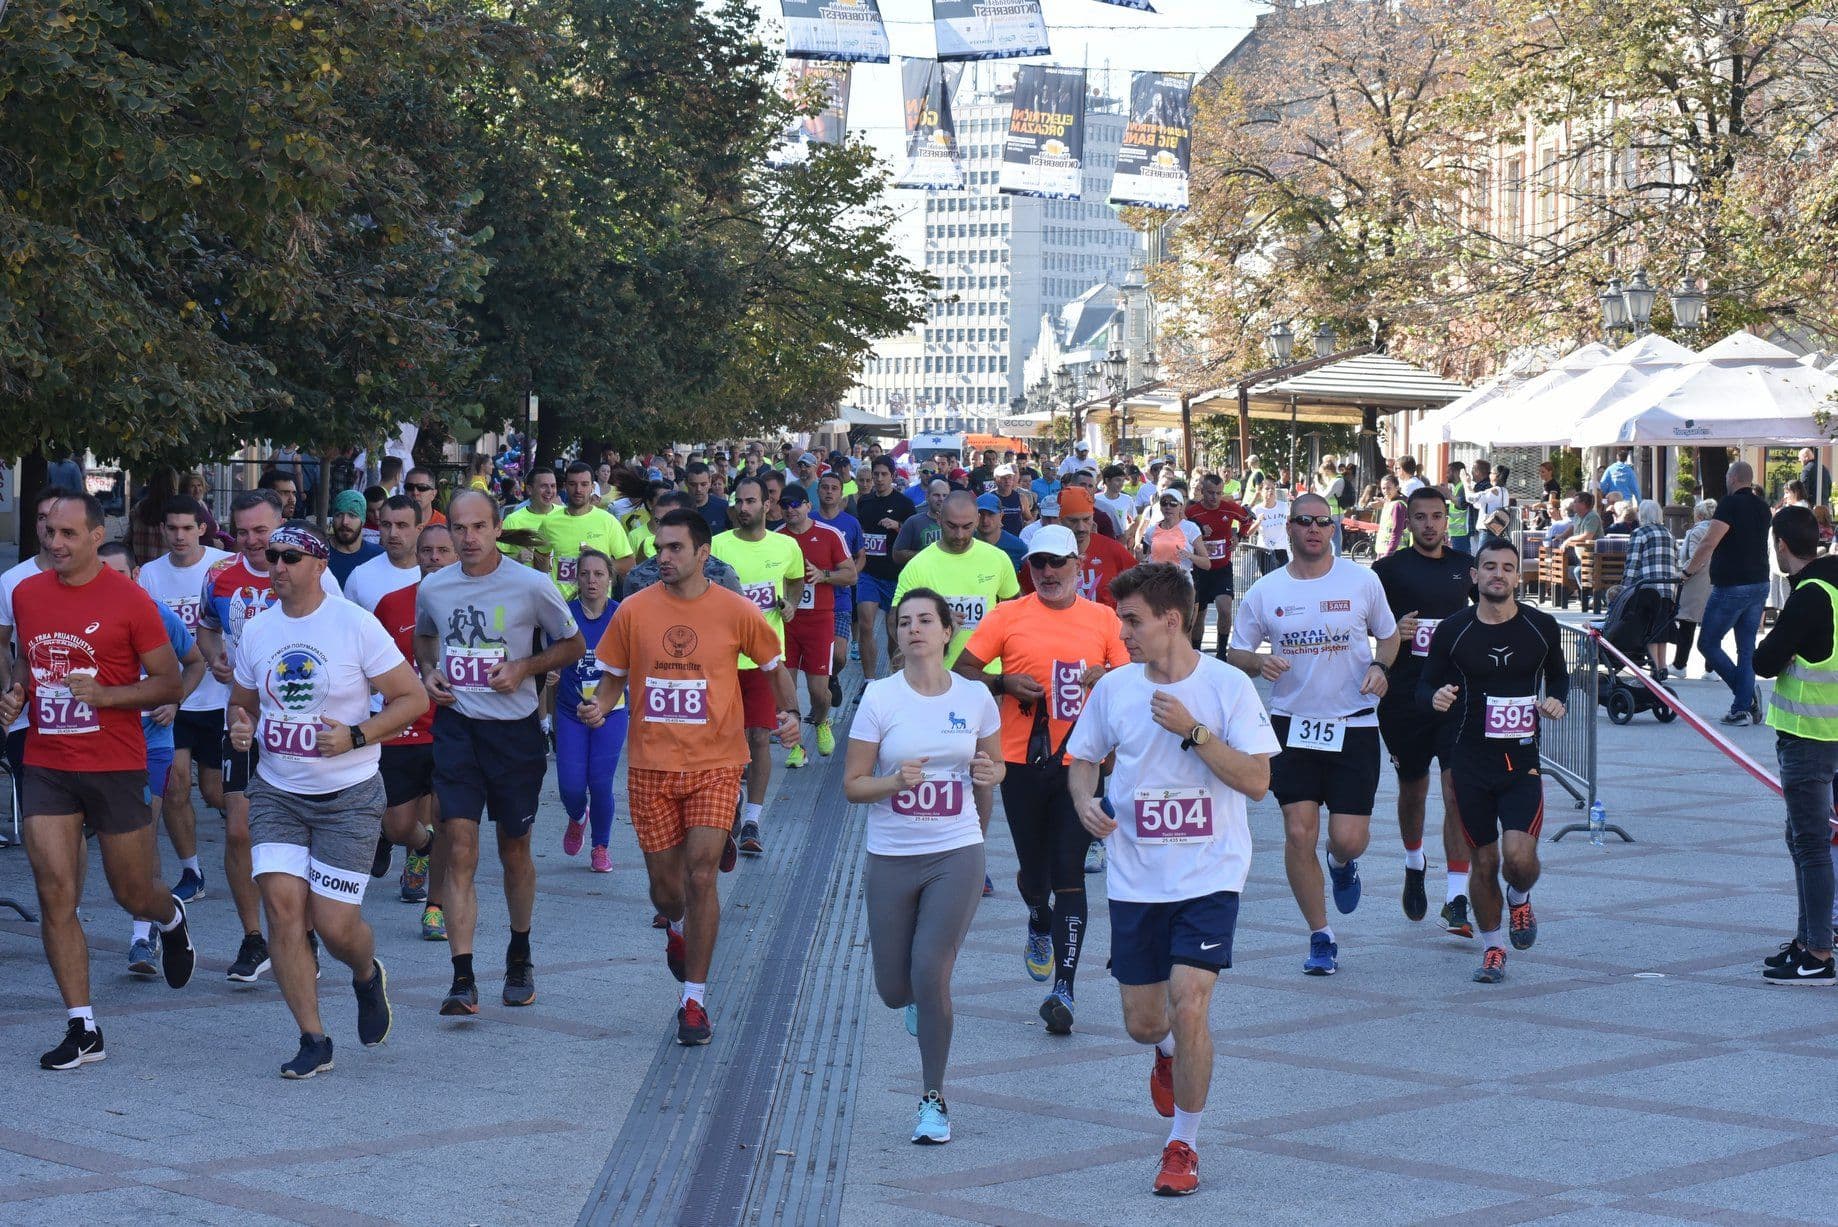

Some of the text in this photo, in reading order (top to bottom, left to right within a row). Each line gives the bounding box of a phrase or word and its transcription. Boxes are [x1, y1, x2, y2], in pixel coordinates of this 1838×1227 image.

[864, 538, 885, 551] 507
[560, 562, 577, 579] 51
[744, 588, 773, 605] 23
[1279, 634, 1350, 647] TRIATHLON
[1282, 629, 1326, 639] TOTAL
[1282, 646, 1319, 656] coaching
[649, 688, 701, 714] 618
[1060, 666, 1082, 718] 503
[41, 698, 93, 723] 574
[1490, 705, 1534, 729] 595
[268, 721, 317, 751] 570
[1300, 720, 1335, 742] 315
[897, 781, 954, 810] 501
[1142, 799, 1207, 831] 504
[322, 874, 360, 895] GOING
[1063, 915, 1082, 969] Kalenji
